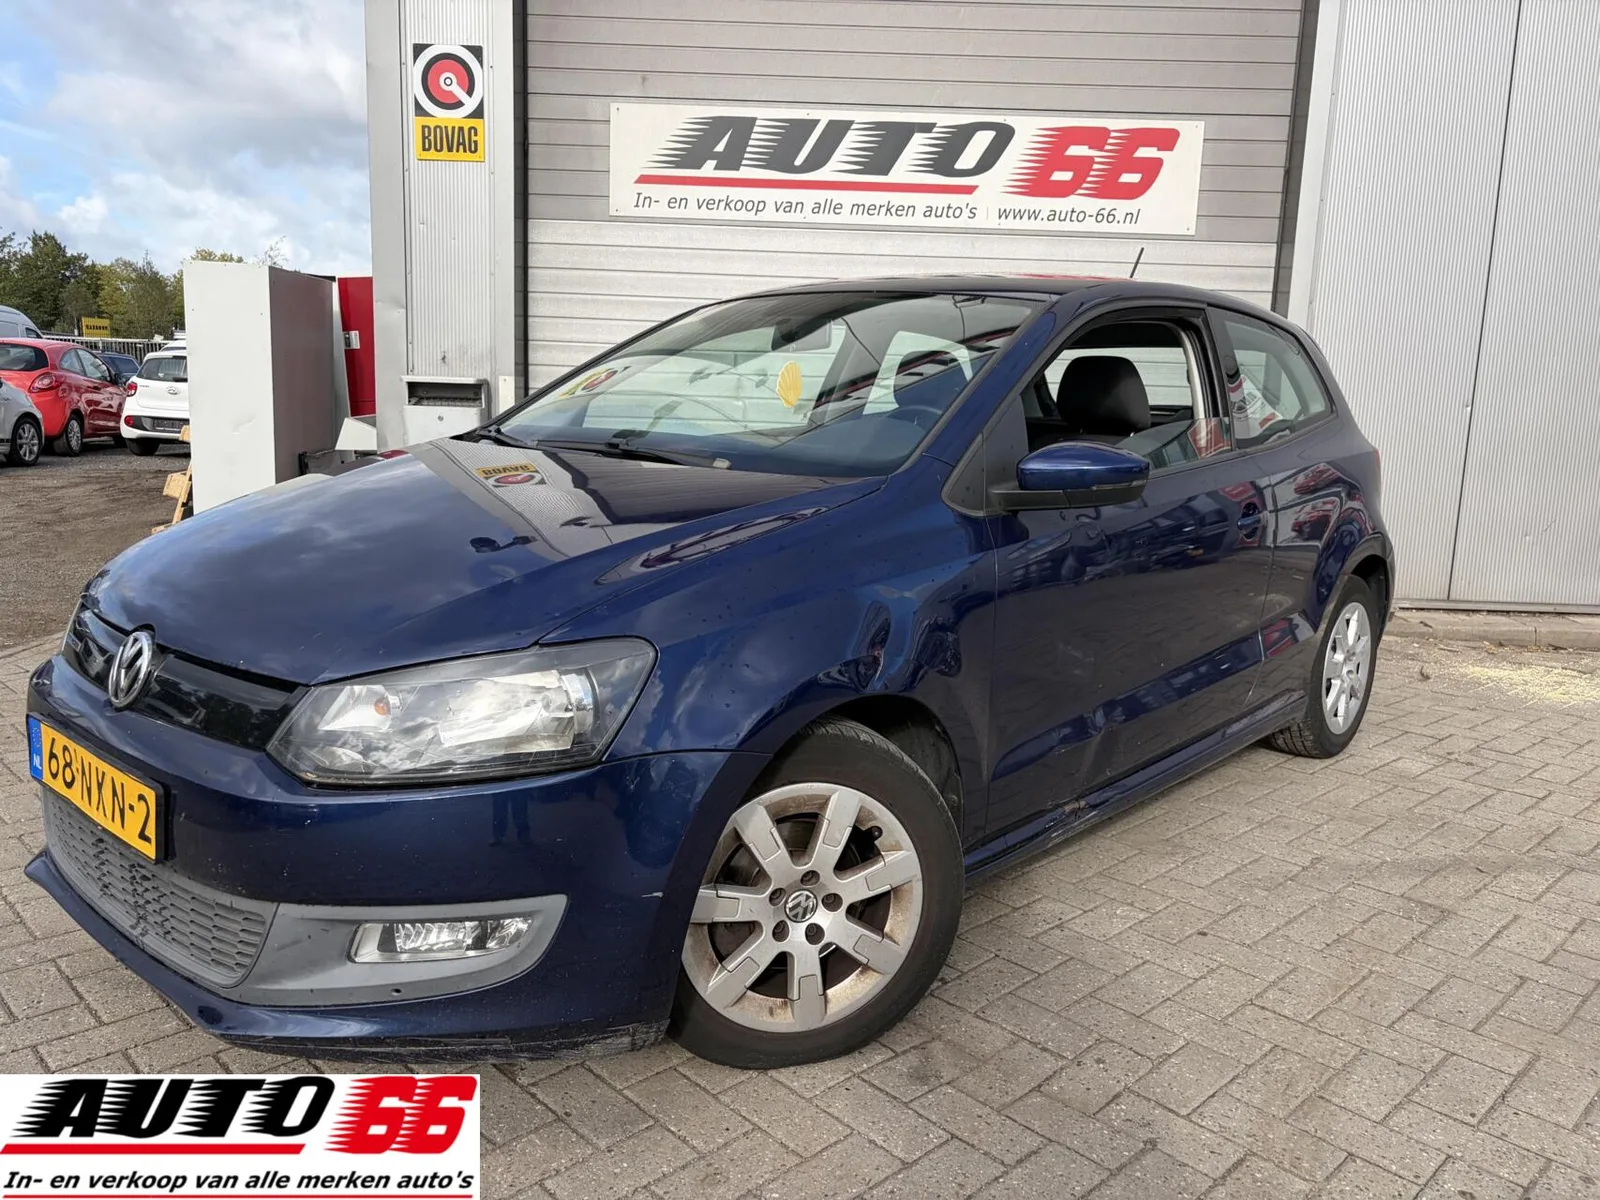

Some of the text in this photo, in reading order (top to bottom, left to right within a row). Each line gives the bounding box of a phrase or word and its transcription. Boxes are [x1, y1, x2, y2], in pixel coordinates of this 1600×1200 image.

[421, 124, 479, 154] BOVAG
[641, 115, 1181, 200] AUTO 66
[633, 192, 1141, 225] In- en verkoop van alle merken auto's www.auto-66.nl
